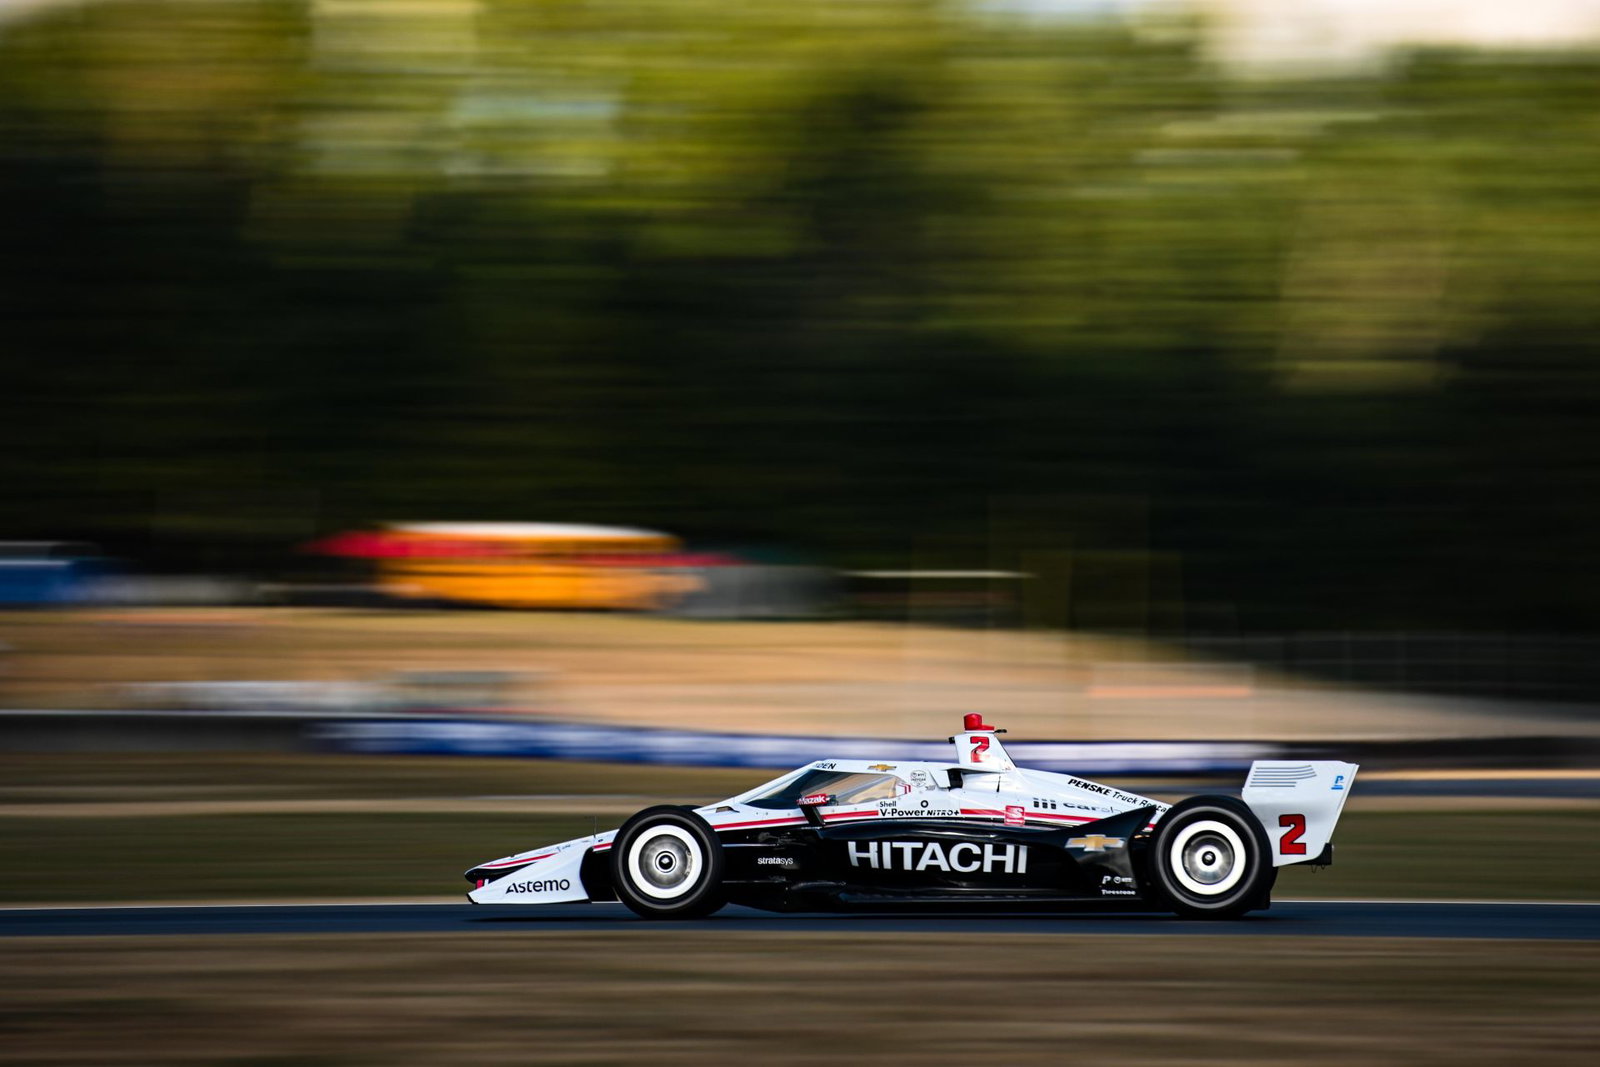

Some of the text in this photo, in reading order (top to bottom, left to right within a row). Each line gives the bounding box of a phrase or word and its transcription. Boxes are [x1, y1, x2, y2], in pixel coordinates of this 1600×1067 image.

[969, 736, 990, 763] 2
[815, 762, 837, 770] DEN
[798, 795, 826, 805] Mazak
[1067, 778, 1168, 813] PENSKE Truck Reta
[879, 800, 897, 808] Shell
[1063, 802, 1123, 814] carsh
[880, 809, 925, 817] V-Power
[1278, 813, 1307, 855] 2
[757, 857, 794, 866] stratasys
[847, 840, 1029, 874] HITACHI
[505, 878, 571, 895] Astemo
